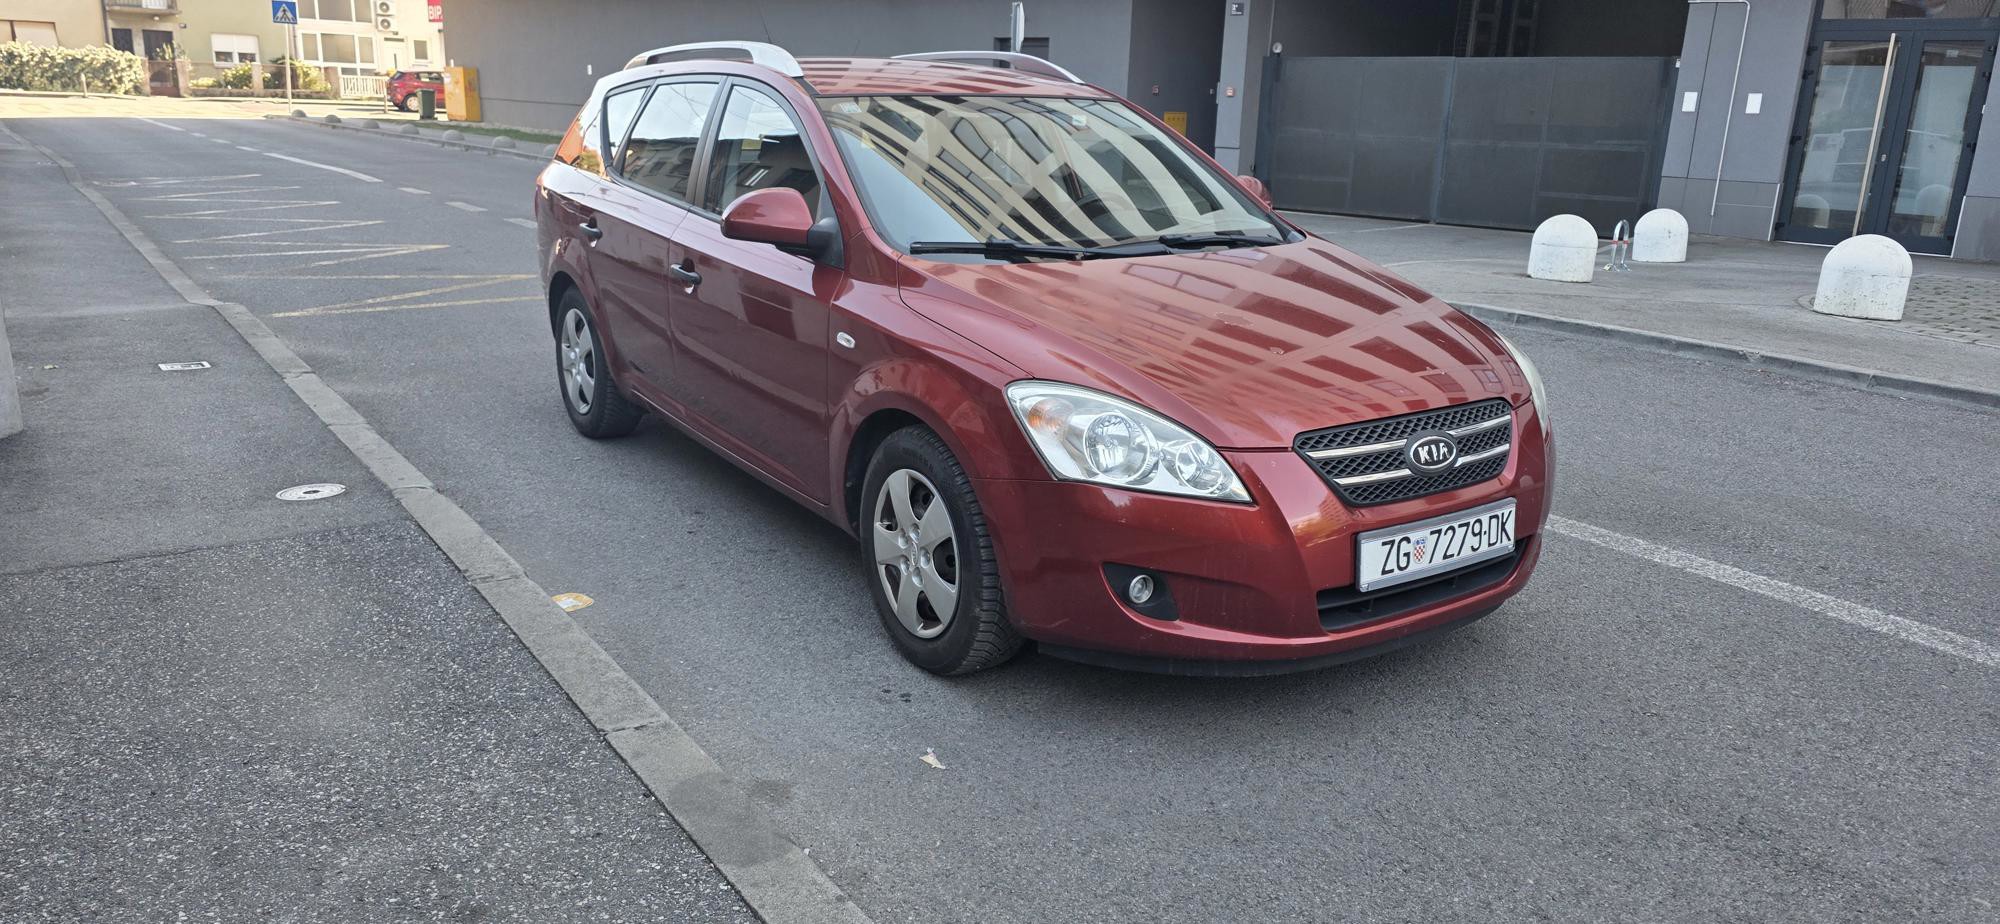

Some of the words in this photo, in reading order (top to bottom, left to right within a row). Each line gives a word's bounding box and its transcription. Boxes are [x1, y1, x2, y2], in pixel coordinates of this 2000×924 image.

[428, 5, 443, 19] BIP
[1417, 442, 1450, 464] KIA
[1380, 536, 1412, 576] ZG
